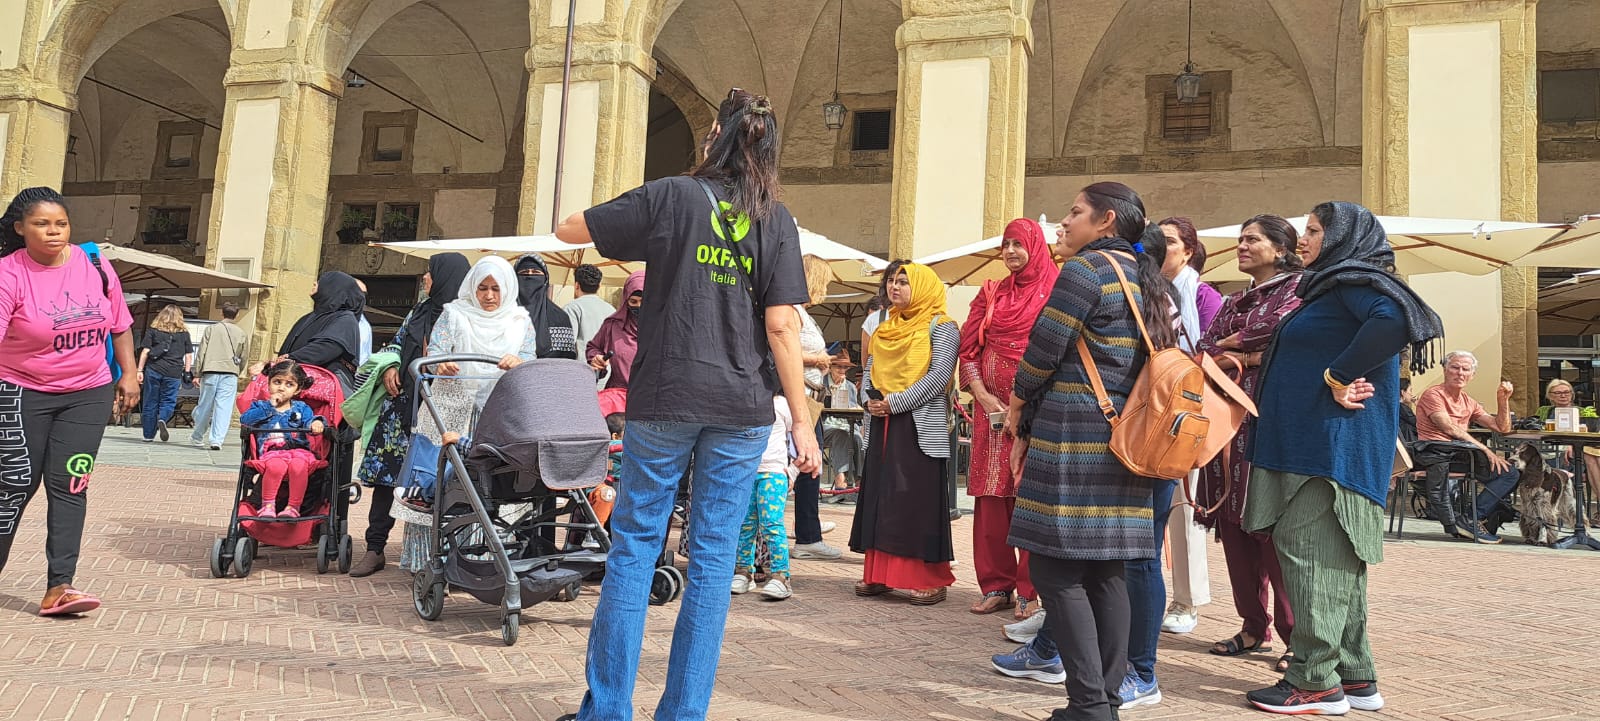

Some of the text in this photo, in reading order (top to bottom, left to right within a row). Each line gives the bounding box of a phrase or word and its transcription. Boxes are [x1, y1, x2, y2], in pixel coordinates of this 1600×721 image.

[696, 244, 753, 275] OXFAM
[710, 270, 737, 285] Italia
[53, 327, 106, 354] QUEEN
[0, 381, 32, 487] ANGELE
